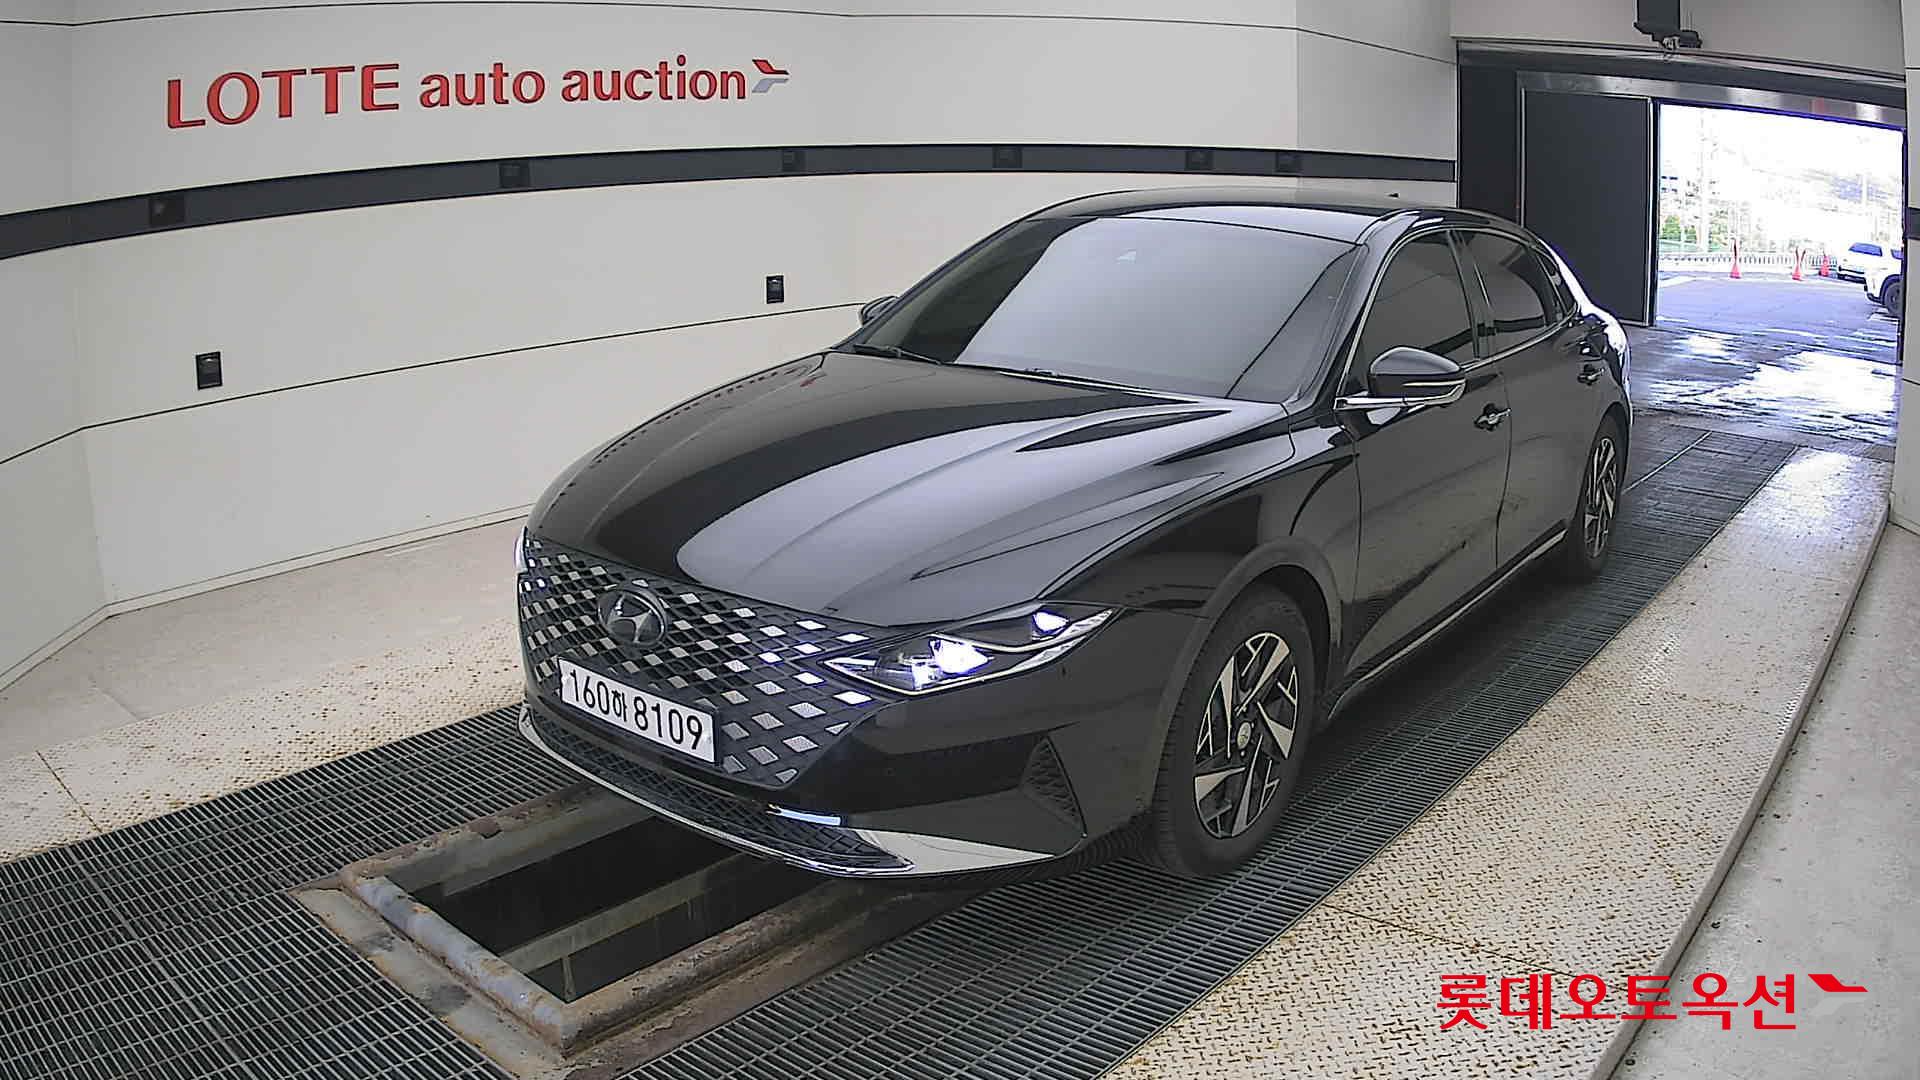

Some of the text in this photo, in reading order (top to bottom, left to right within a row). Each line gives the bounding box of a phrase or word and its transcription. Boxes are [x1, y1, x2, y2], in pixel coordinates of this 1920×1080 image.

[167, 55, 748, 129] LOTTE auto auction
[569, 669, 703, 750] 160하 8109
